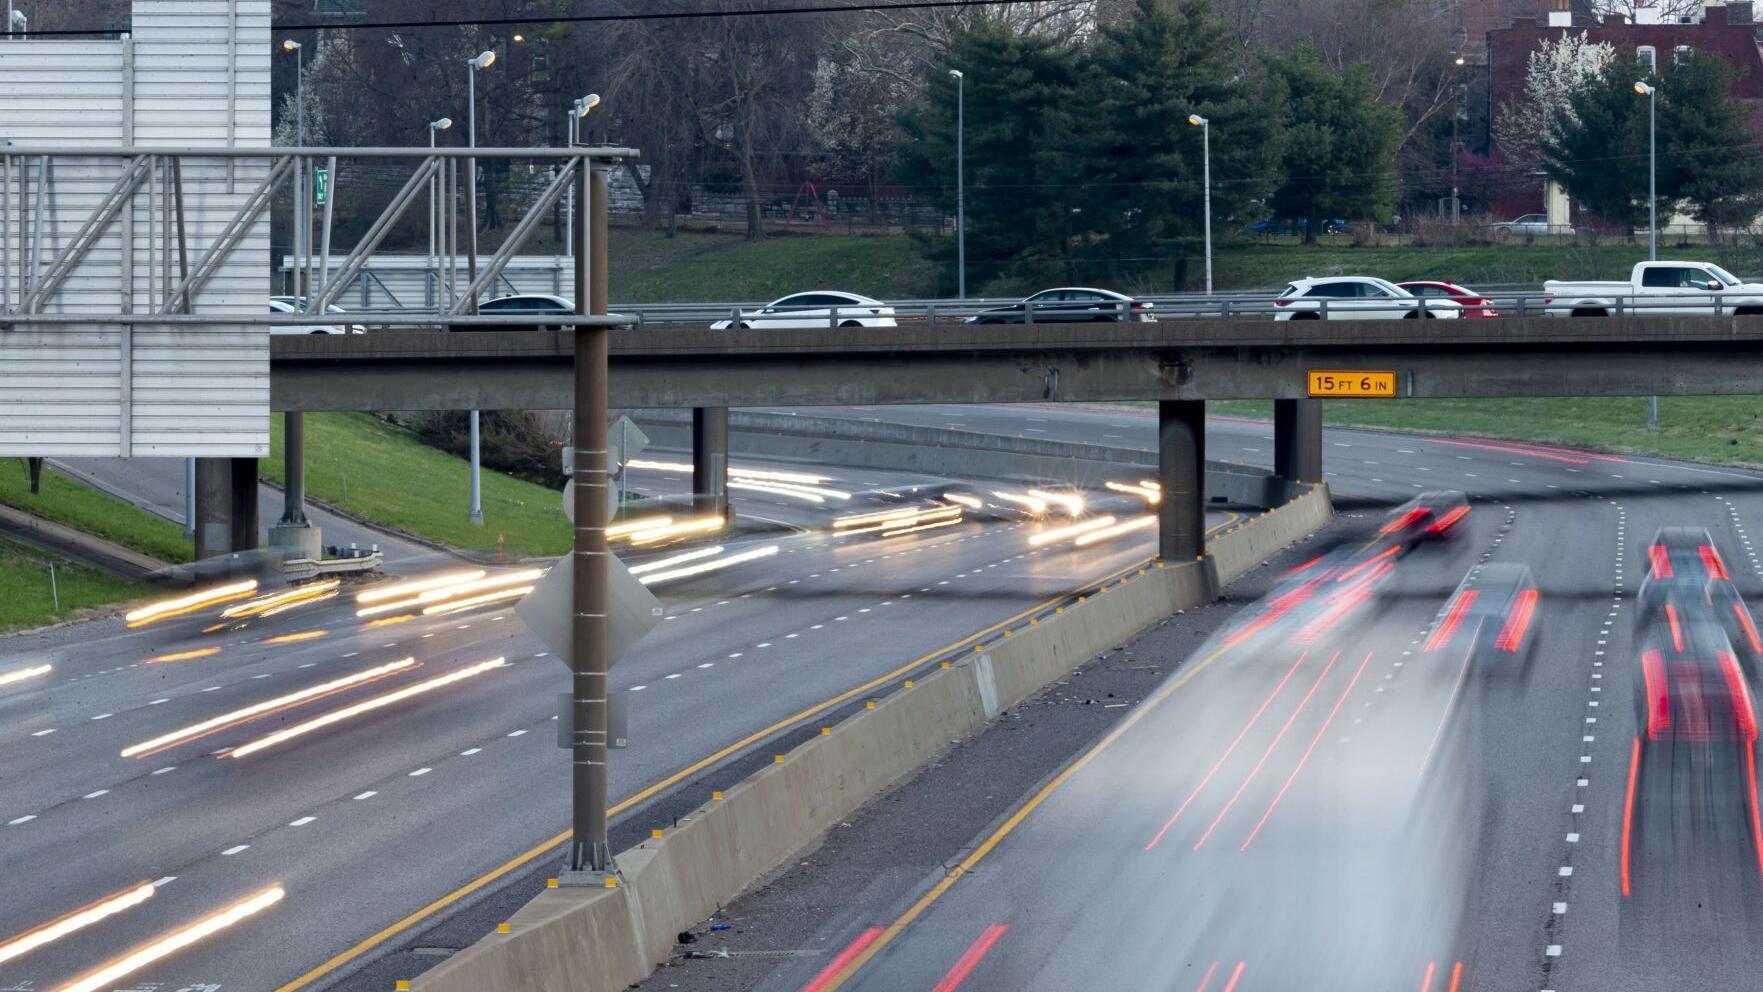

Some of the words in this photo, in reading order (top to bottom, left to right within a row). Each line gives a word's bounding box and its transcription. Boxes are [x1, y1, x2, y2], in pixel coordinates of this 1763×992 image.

[1317, 376, 1335, 391] 15
[1339, 381, 1353, 391] FT
[1360, 377, 1371, 391] 6
[1375, 381, 1387, 391] IN
